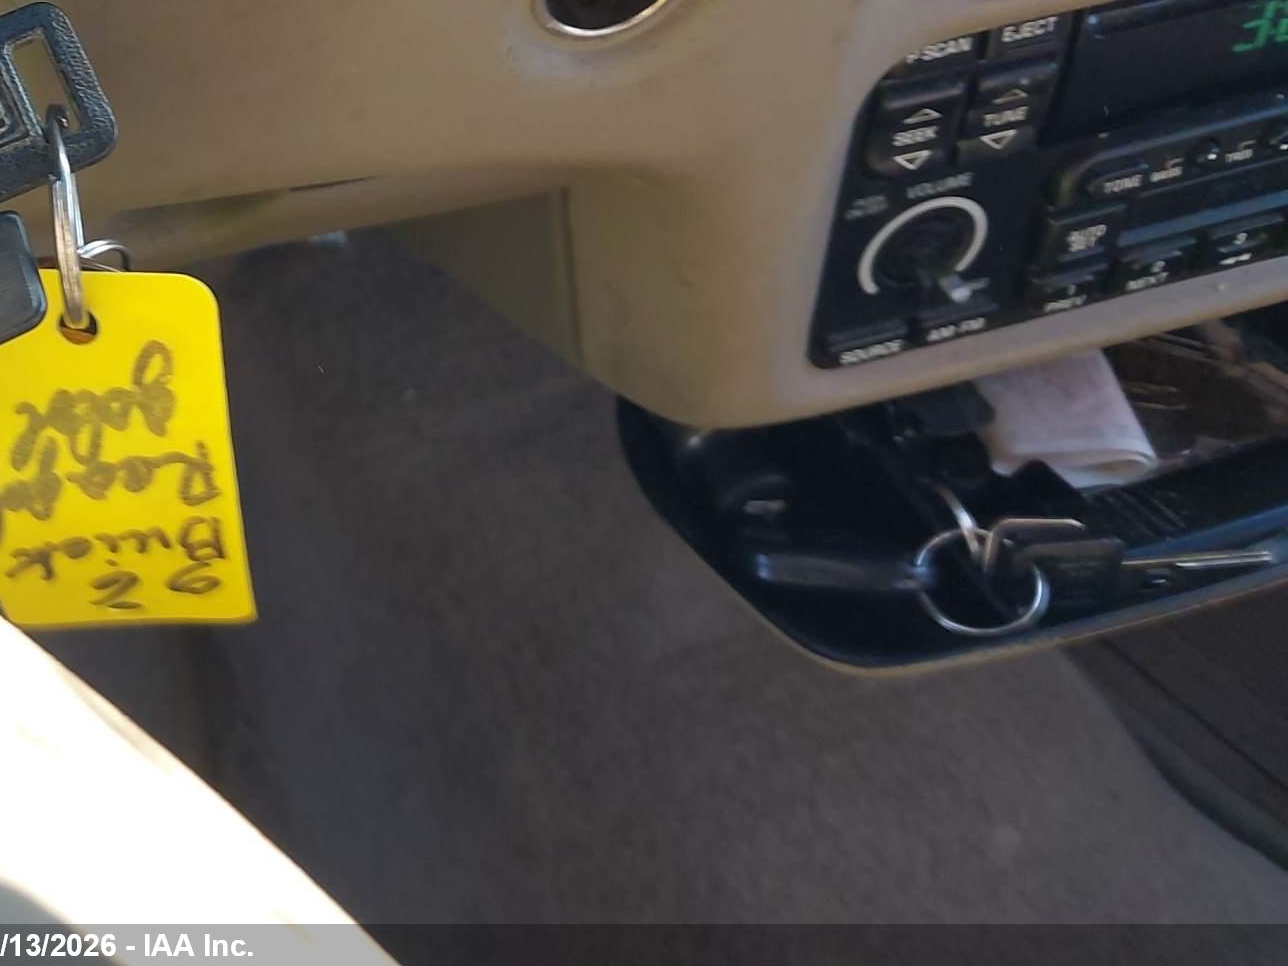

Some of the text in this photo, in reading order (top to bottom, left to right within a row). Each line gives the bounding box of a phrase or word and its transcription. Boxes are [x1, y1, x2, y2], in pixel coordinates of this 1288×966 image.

[1000, 16, 1059, 43] EJECT
[892, 125, 941, 146] SEEK
[907, 171, 975, 199] VOLUME
